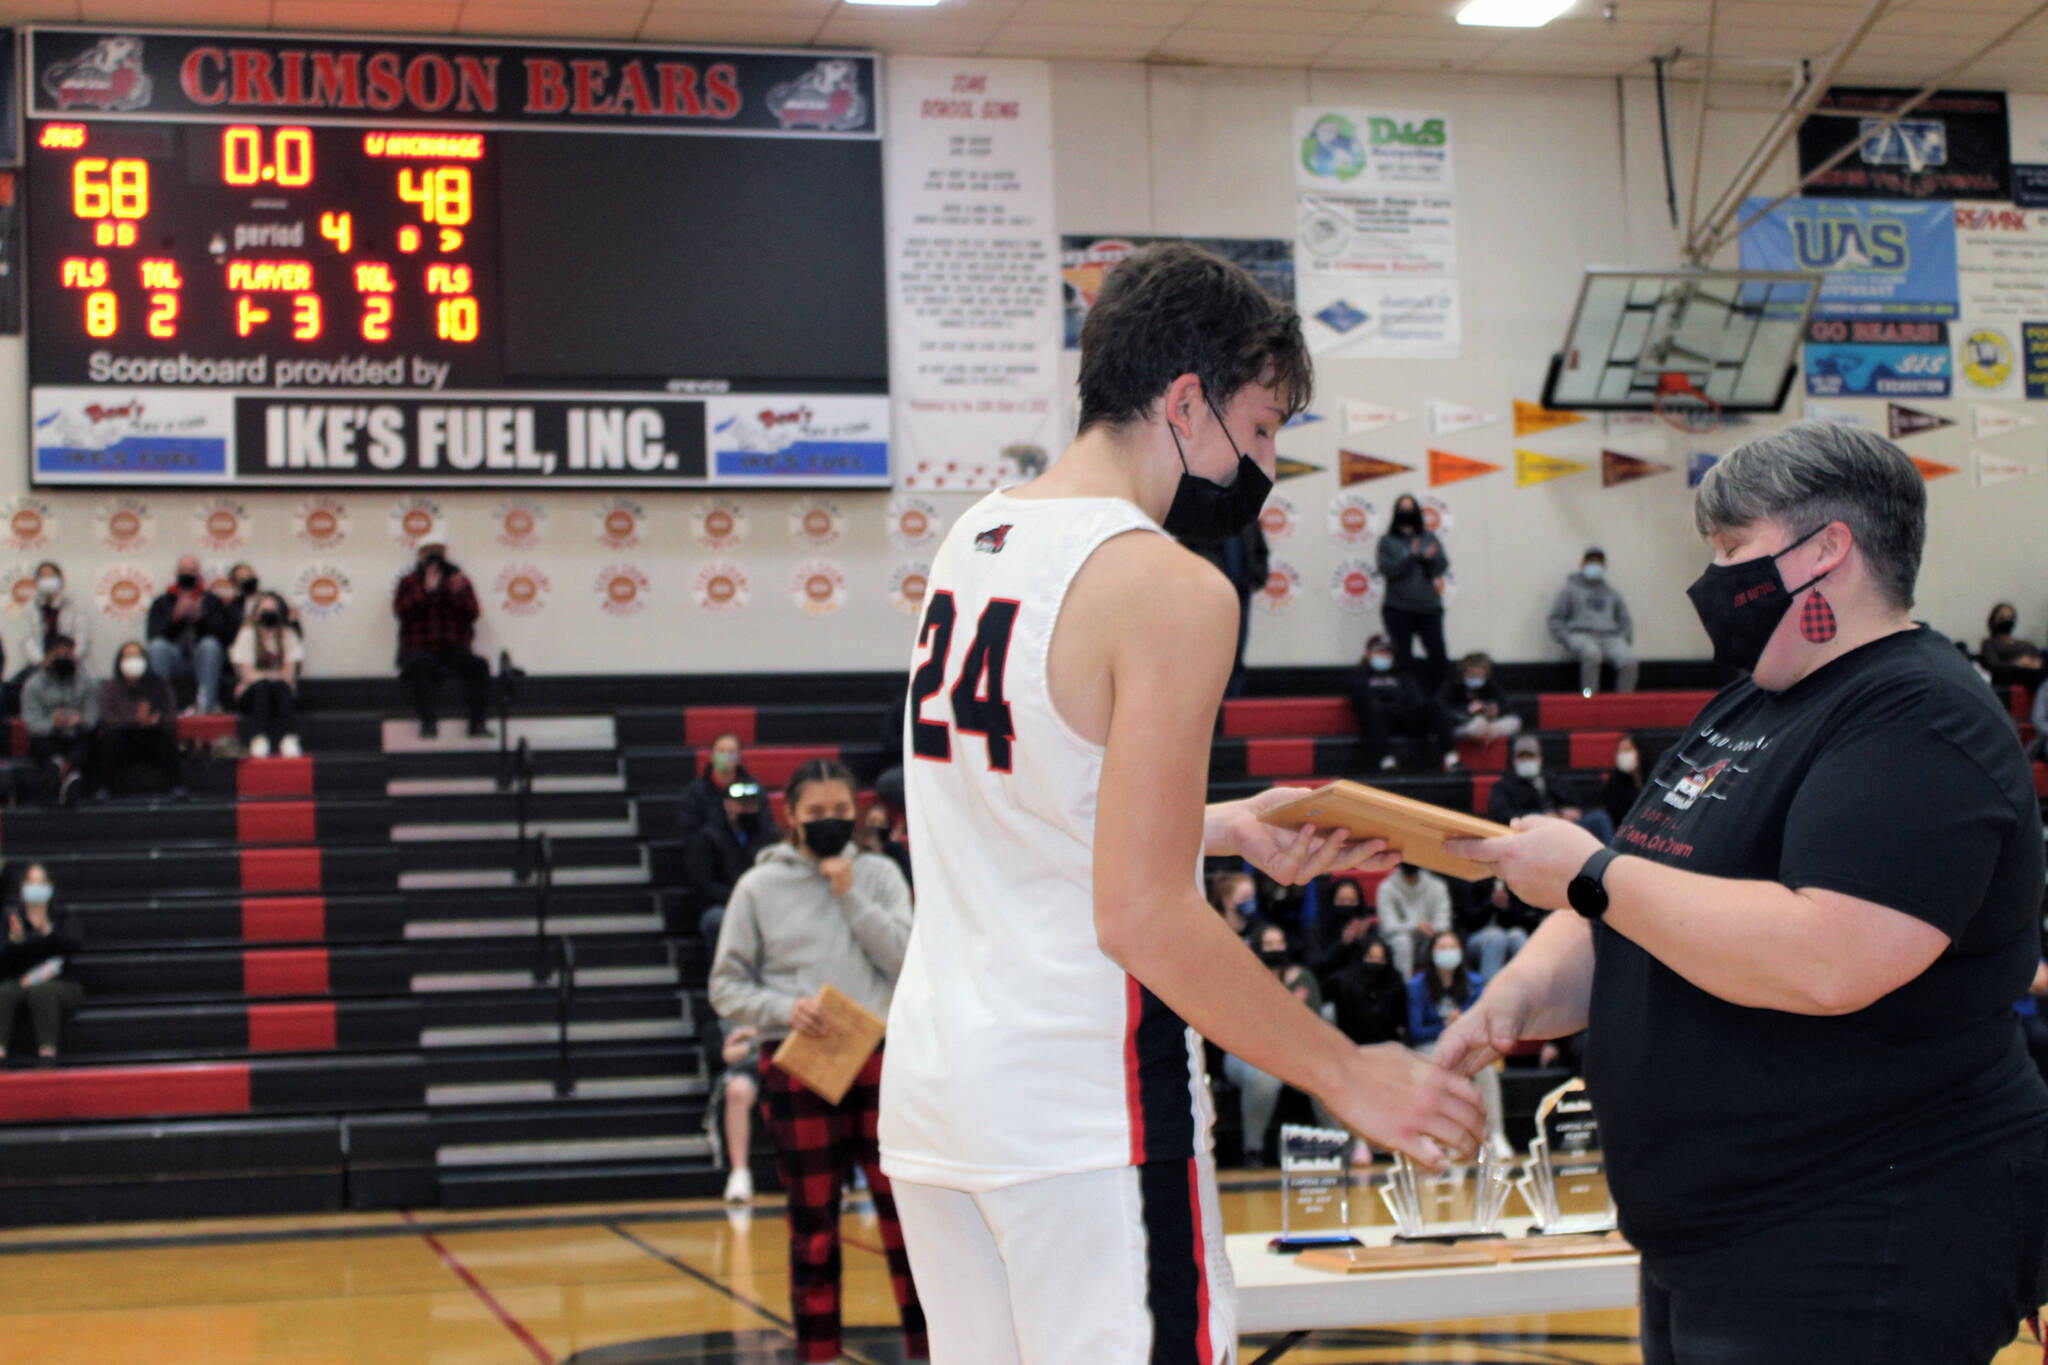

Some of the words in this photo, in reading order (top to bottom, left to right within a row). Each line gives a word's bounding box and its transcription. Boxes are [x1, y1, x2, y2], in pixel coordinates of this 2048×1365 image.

[180, 47, 499, 112] CRIMSON
[523, 57, 743, 120] BEARS
[921, 100, 974, 119] SCHOOL
[982, 101, 1019, 120] SONG
[223, 126, 313, 186] 0.0
[1367, 116, 1446, 146] D&S
[73, 158, 149, 219] 68
[398, 166, 471, 226] 48
[235, 222, 304, 250] period
[319, 211, 352, 253] 4
[1791, 217, 1910, 273] UAS
[61, 258, 108, 288] FLS
[227, 261, 313, 291] PLAYER
[426, 263, 472, 294] FLS
[86, 291, 117, 337] 8
[148, 293, 179, 338] 2
[361, 295, 391, 341] 2
[436, 296, 478, 342] 10
[1812, 321, 1847, 341] GO
[89, 351, 266, 383] Scoreboard
[275, 355, 404, 388] provided
[412, 355, 450, 391] by
[266, 404, 406, 469] IKE'S
[418, 406, 556, 475] FUEL,
[567, 407, 680, 471] INC.
[910, 590, 1021, 774] 24
